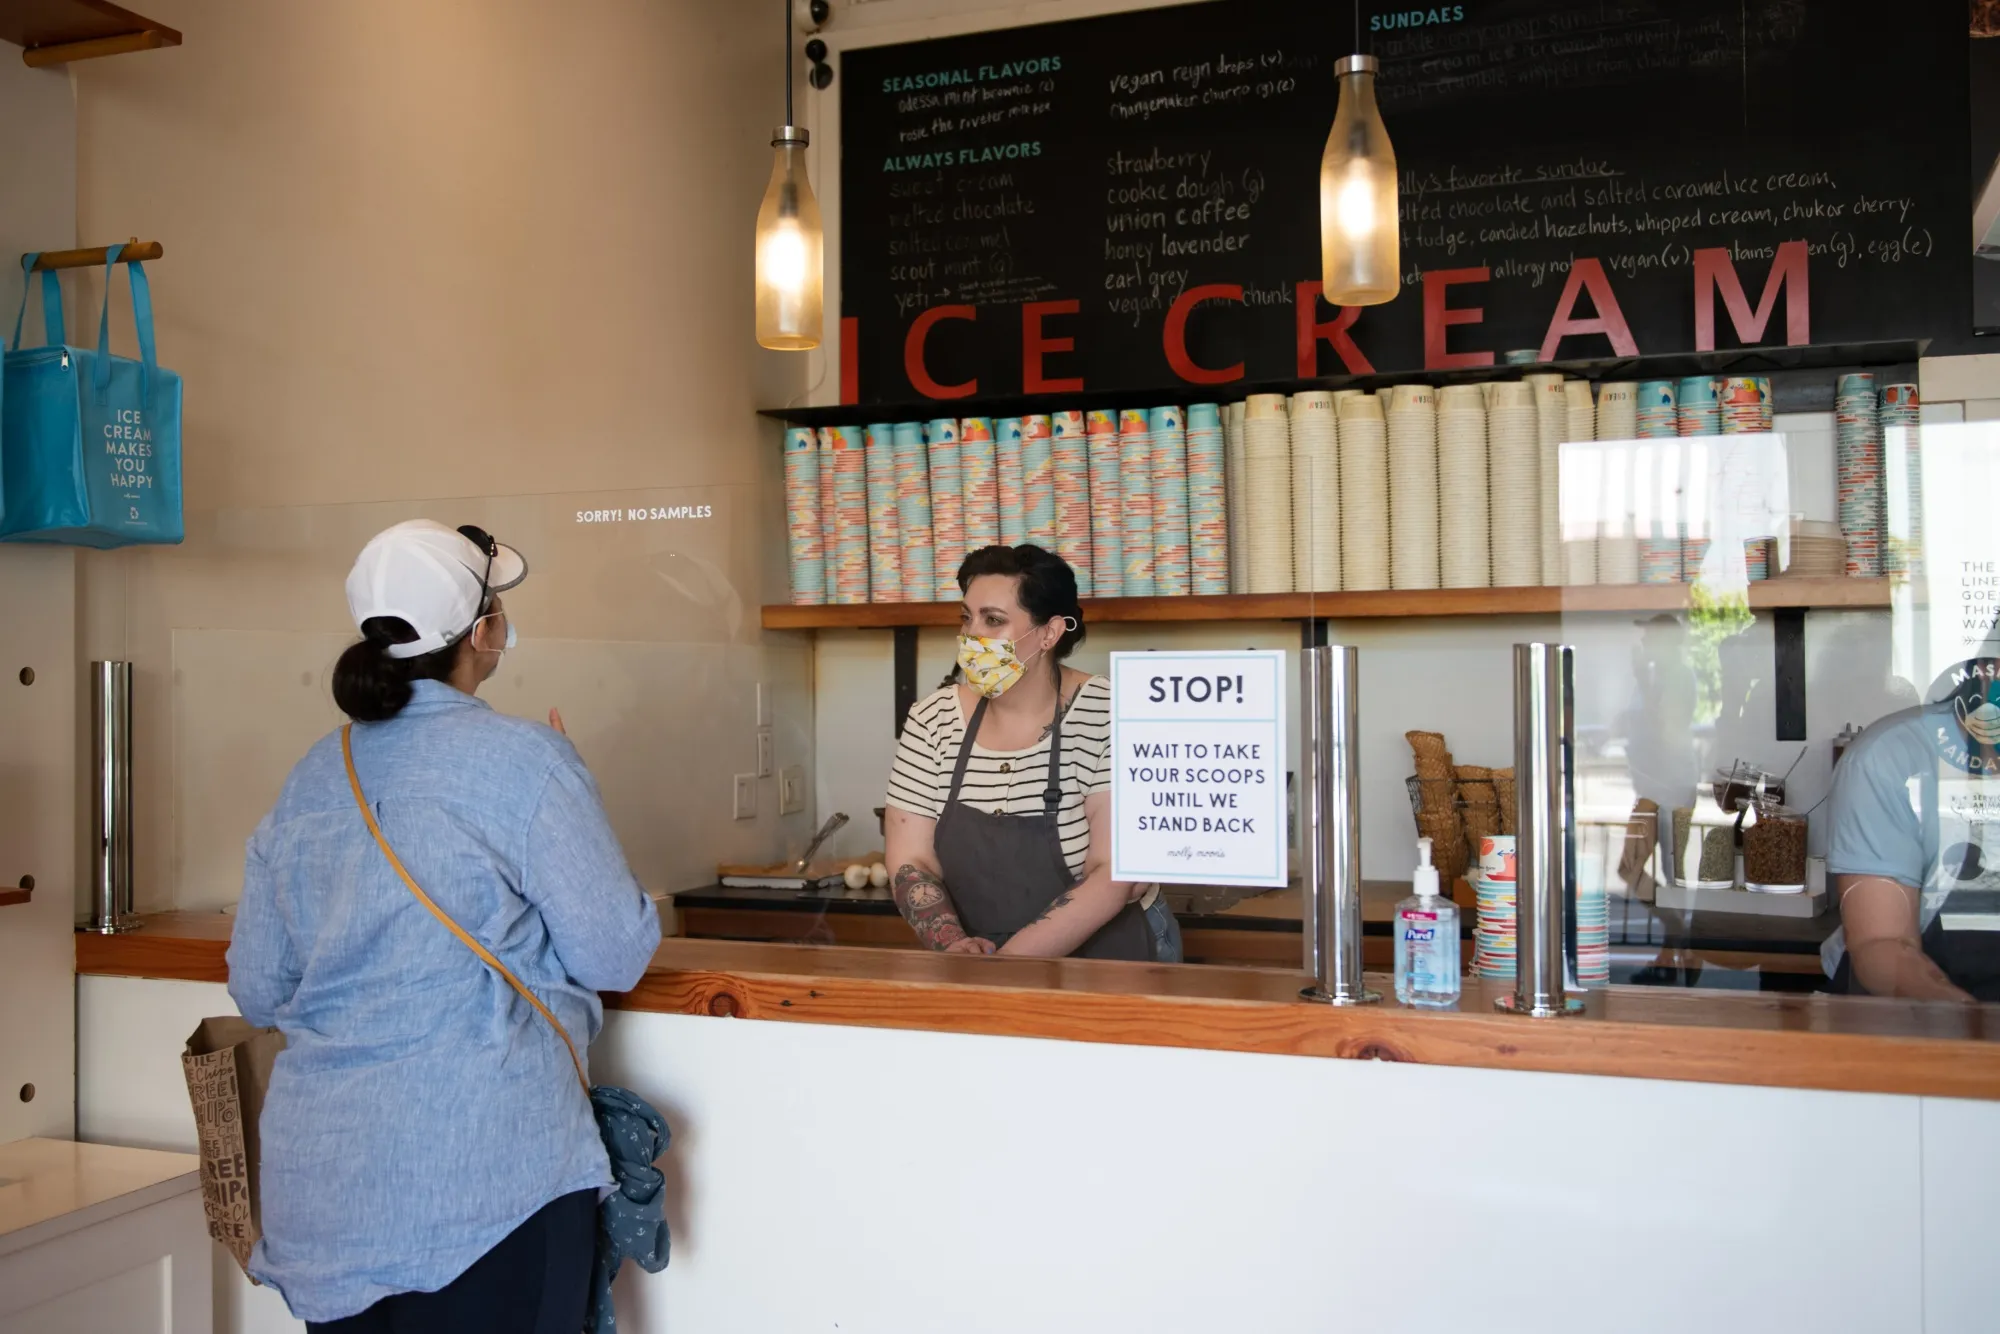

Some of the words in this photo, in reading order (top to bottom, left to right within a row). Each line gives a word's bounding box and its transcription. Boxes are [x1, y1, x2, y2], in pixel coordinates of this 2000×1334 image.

[1369, 5, 1464, 32] SUNDAES
[882, 68, 974, 93] SEASONAL
[978, 56, 1062, 81] FLAVORS
[1110, 68, 1165, 95] vegan
[931, 116, 955, 135] the
[883, 151, 954, 173] ALWAYS
[959, 141, 1042, 165] FLAVORS
[1107, 147, 1213, 178] strawberry
[1107, 178, 1168, 204] cookie
[1450, 164, 1525, 192] favorite
[953, 192, 1036, 221] chocolate
[1399, 200, 1442, 224] elted
[1449, 192, 1534, 218] chocolate
[1540, 187, 1577, 211] and
[1584, 178, 1646, 206] salted
[1651, 168, 1731, 201] caramel
[1107, 208, 1166, 233] union
[1479, 220, 1540, 244] candied
[1635, 208, 1702, 237] whipped
[1783, 197, 1846, 221] chukar
[1104, 238, 1154, 268] honey
[1161, 231, 1252, 257] lavender
[889, 257, 937, 281] scout
[1104, 261, 1142, 290] earl
[1148, 269, 1190, 299] grey
[1495, 256, 1546, 288] allergy
[894, 282, 930, 318] yeti
[1108, 296, 1163, 328] vegan
[840, 299, 1085, 405] ICE
[1162, 240, 1811, 385] CREAM
[117, 409, 141, 425] ICE
[103, 424, 152, 441] CREAM
[105, 440, 152, 457] MAKES
[115, 457, 145, 472] YOU
[110, 473, 153, 489] HAPPY
[576, 508, 622, 523] SORRY!
[628, 508, 648, 521] NO
[650, 505, 712, 520] SAMPLES
[1960, 561, 1995, 573] THE
[1961, 576, 2000, 587] LINE
[1962, 619, 1999, 630] WAY
[1148, 675, 1244, 705] STOP!
[1133, 743, 1180, 759] WAIT
[1184, 743, 1209, 759] TO
[1213, 743, 1261, 760] TAKE
[1129, 767, 1180, 783] YOUR
[1185, 768, 1266, 784] SCOOPS
[1151, 792, 1204, 808] UNTIL
[1209, 793, 1239, 808] WE
[1138, 816, 1198, 832] STAND
[1203, 817, 1256, 833] BACK
